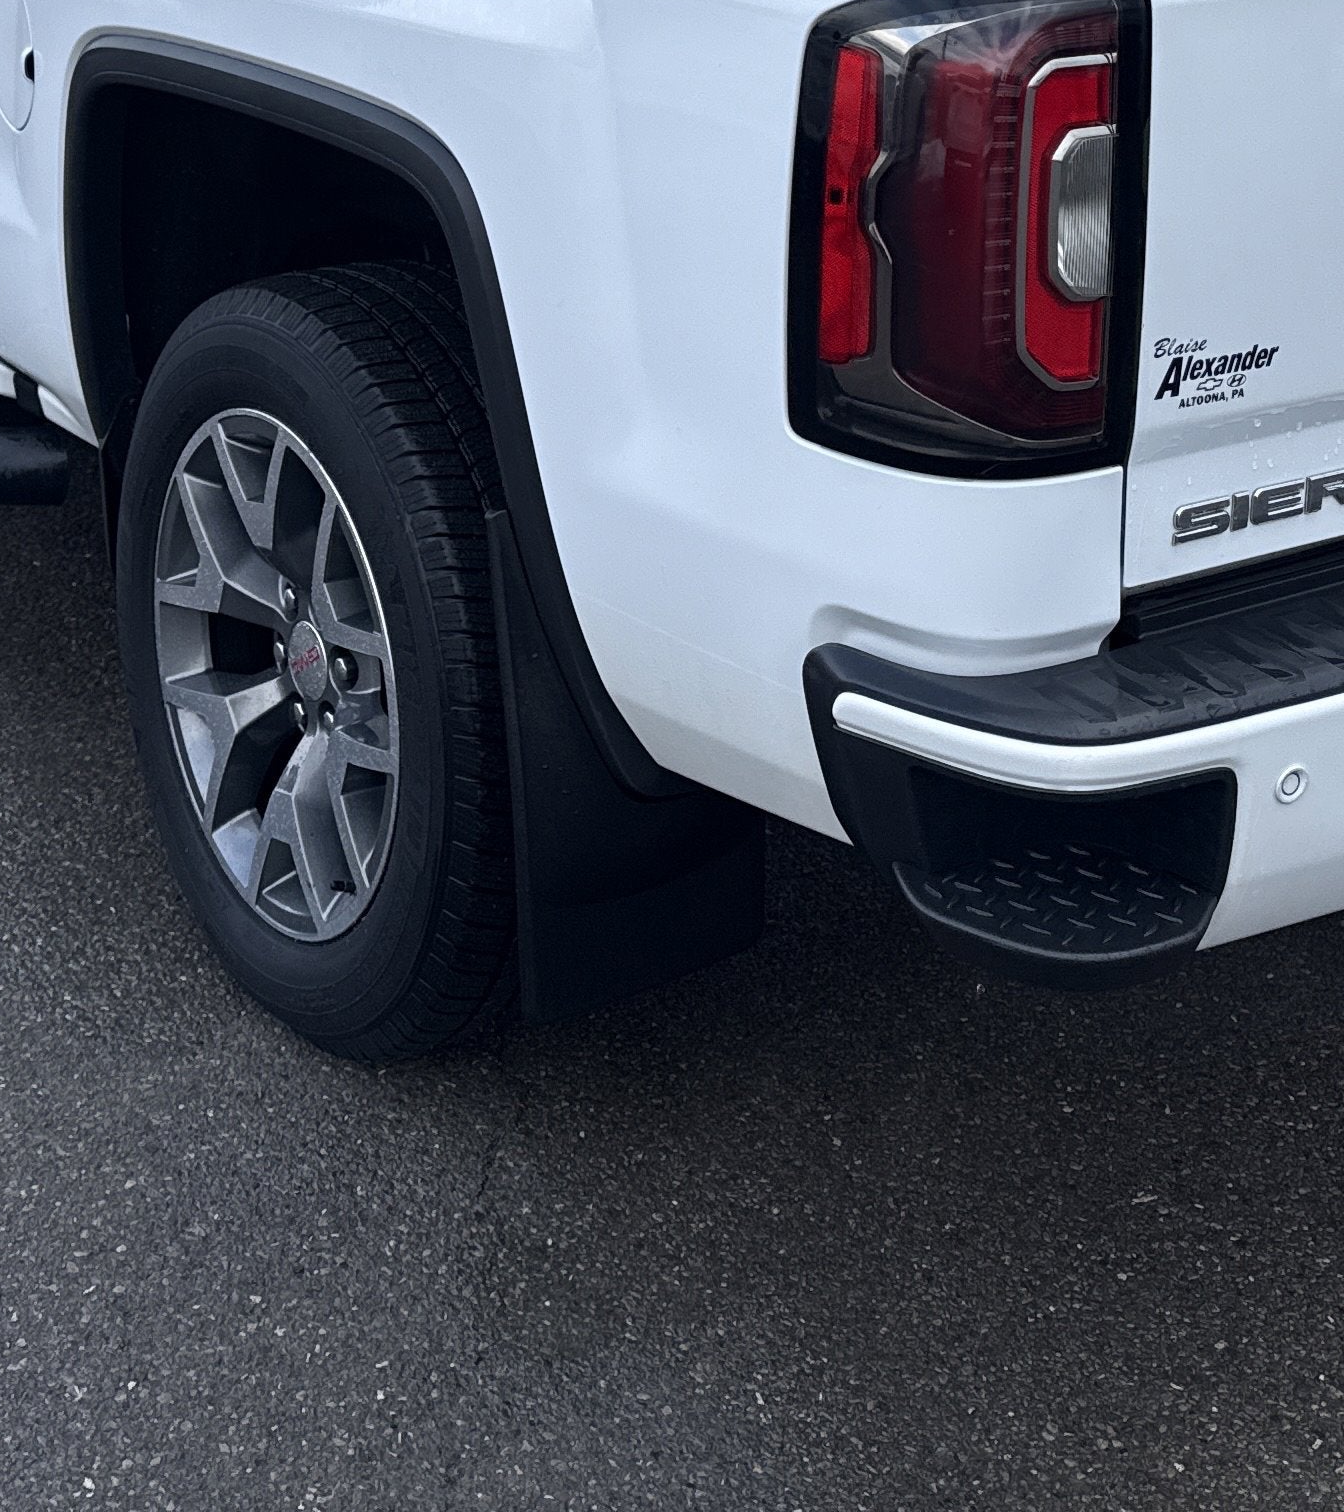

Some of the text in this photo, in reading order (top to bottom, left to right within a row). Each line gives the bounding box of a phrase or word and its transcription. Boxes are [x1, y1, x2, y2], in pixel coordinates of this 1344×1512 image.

[1154, 337, 1207, 359] Blaise
[1154, 344, 1280, 401] Alexander
[1178, 388, 1244, 409] ALTOONA, PA
